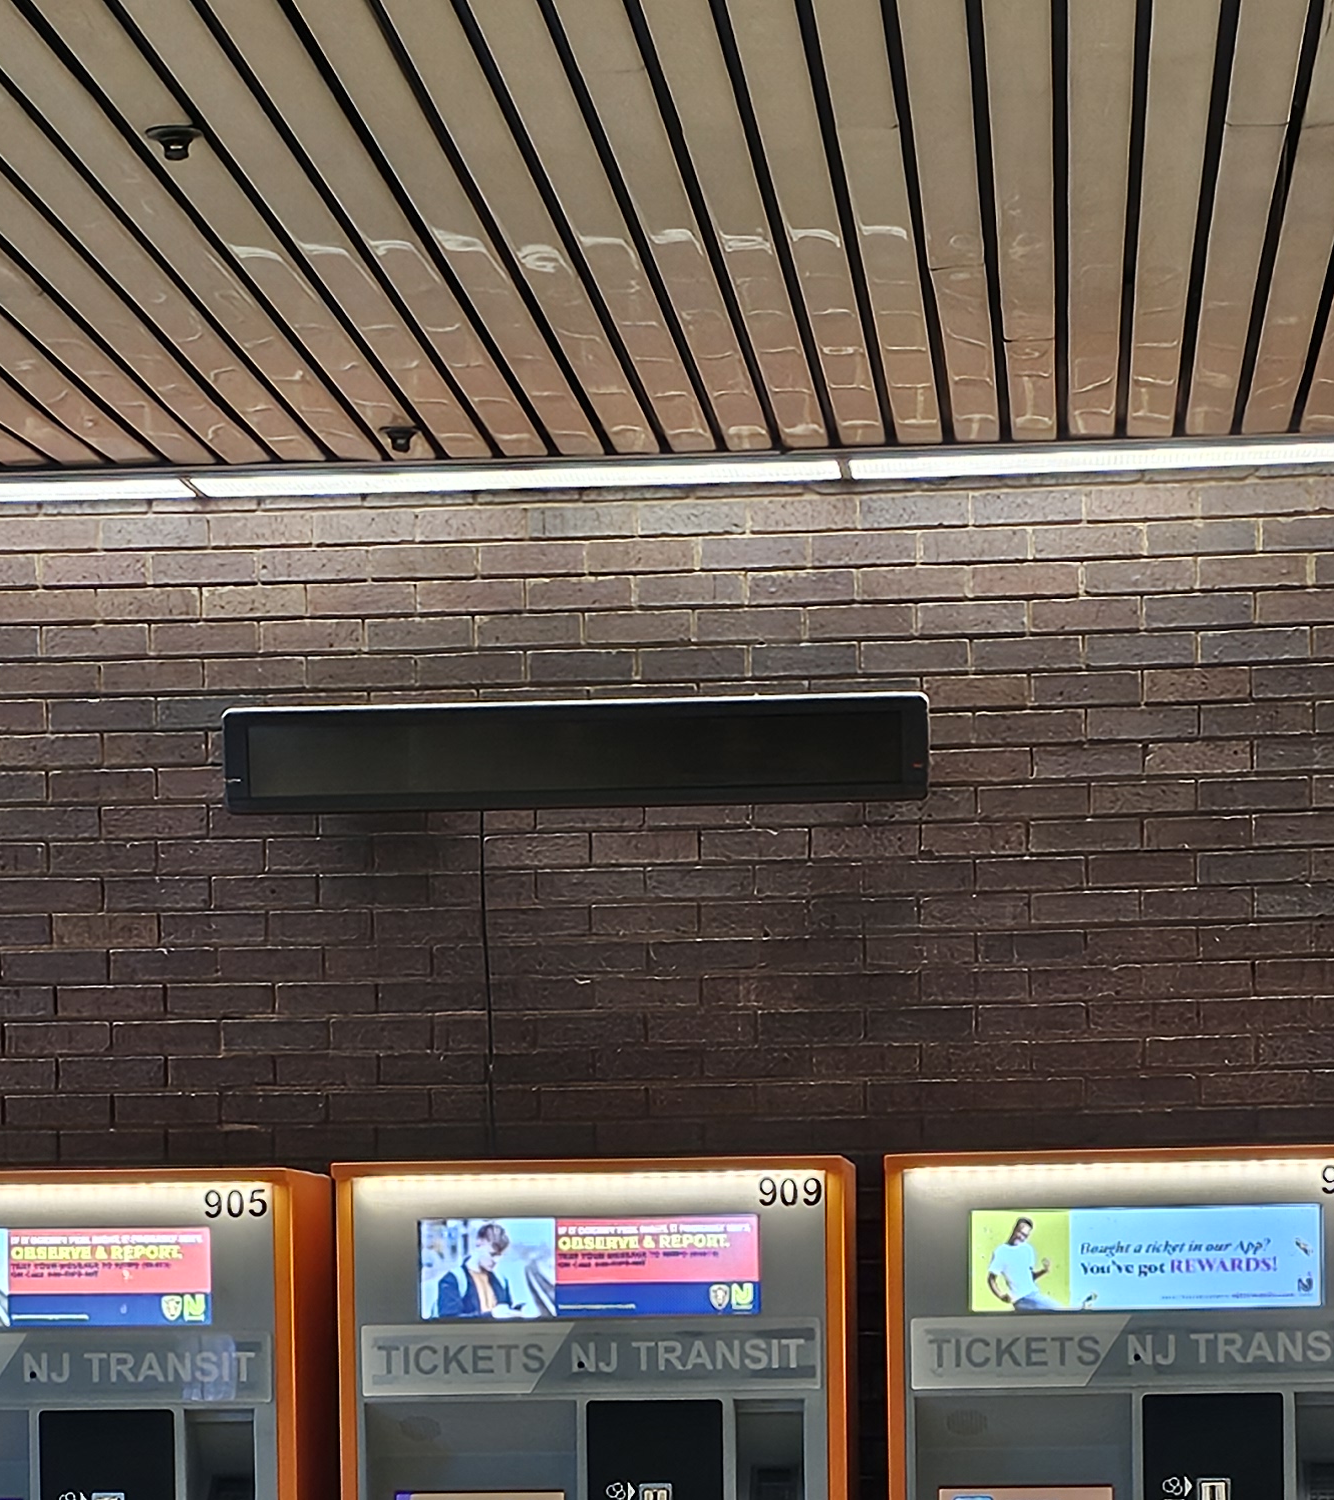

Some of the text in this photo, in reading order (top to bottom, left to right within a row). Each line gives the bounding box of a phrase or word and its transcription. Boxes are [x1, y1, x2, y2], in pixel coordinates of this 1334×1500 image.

[204, 1189, 267, 1218] 905
[758, 1177, 822, 1207] 909
[10, 1246, 92, 1260] OBSERVE
[558, 1236, 640, 1250] OBSERVE
[1081, 1238, 1271, 1257] Bought a ticket in our App?
[1081, 1256, 1277, 1277] You've got REWARDS!
[377, 1343, 545, 1375] TICKETS
[571, 1339, 804, 1373] NJ TRANSIT
[928, 1335, 1101, 1368] TICKETS
[1127, 1333, 1176, 1365] NJ
[23, 1351, 255, 1383] NJ TRANSIT
